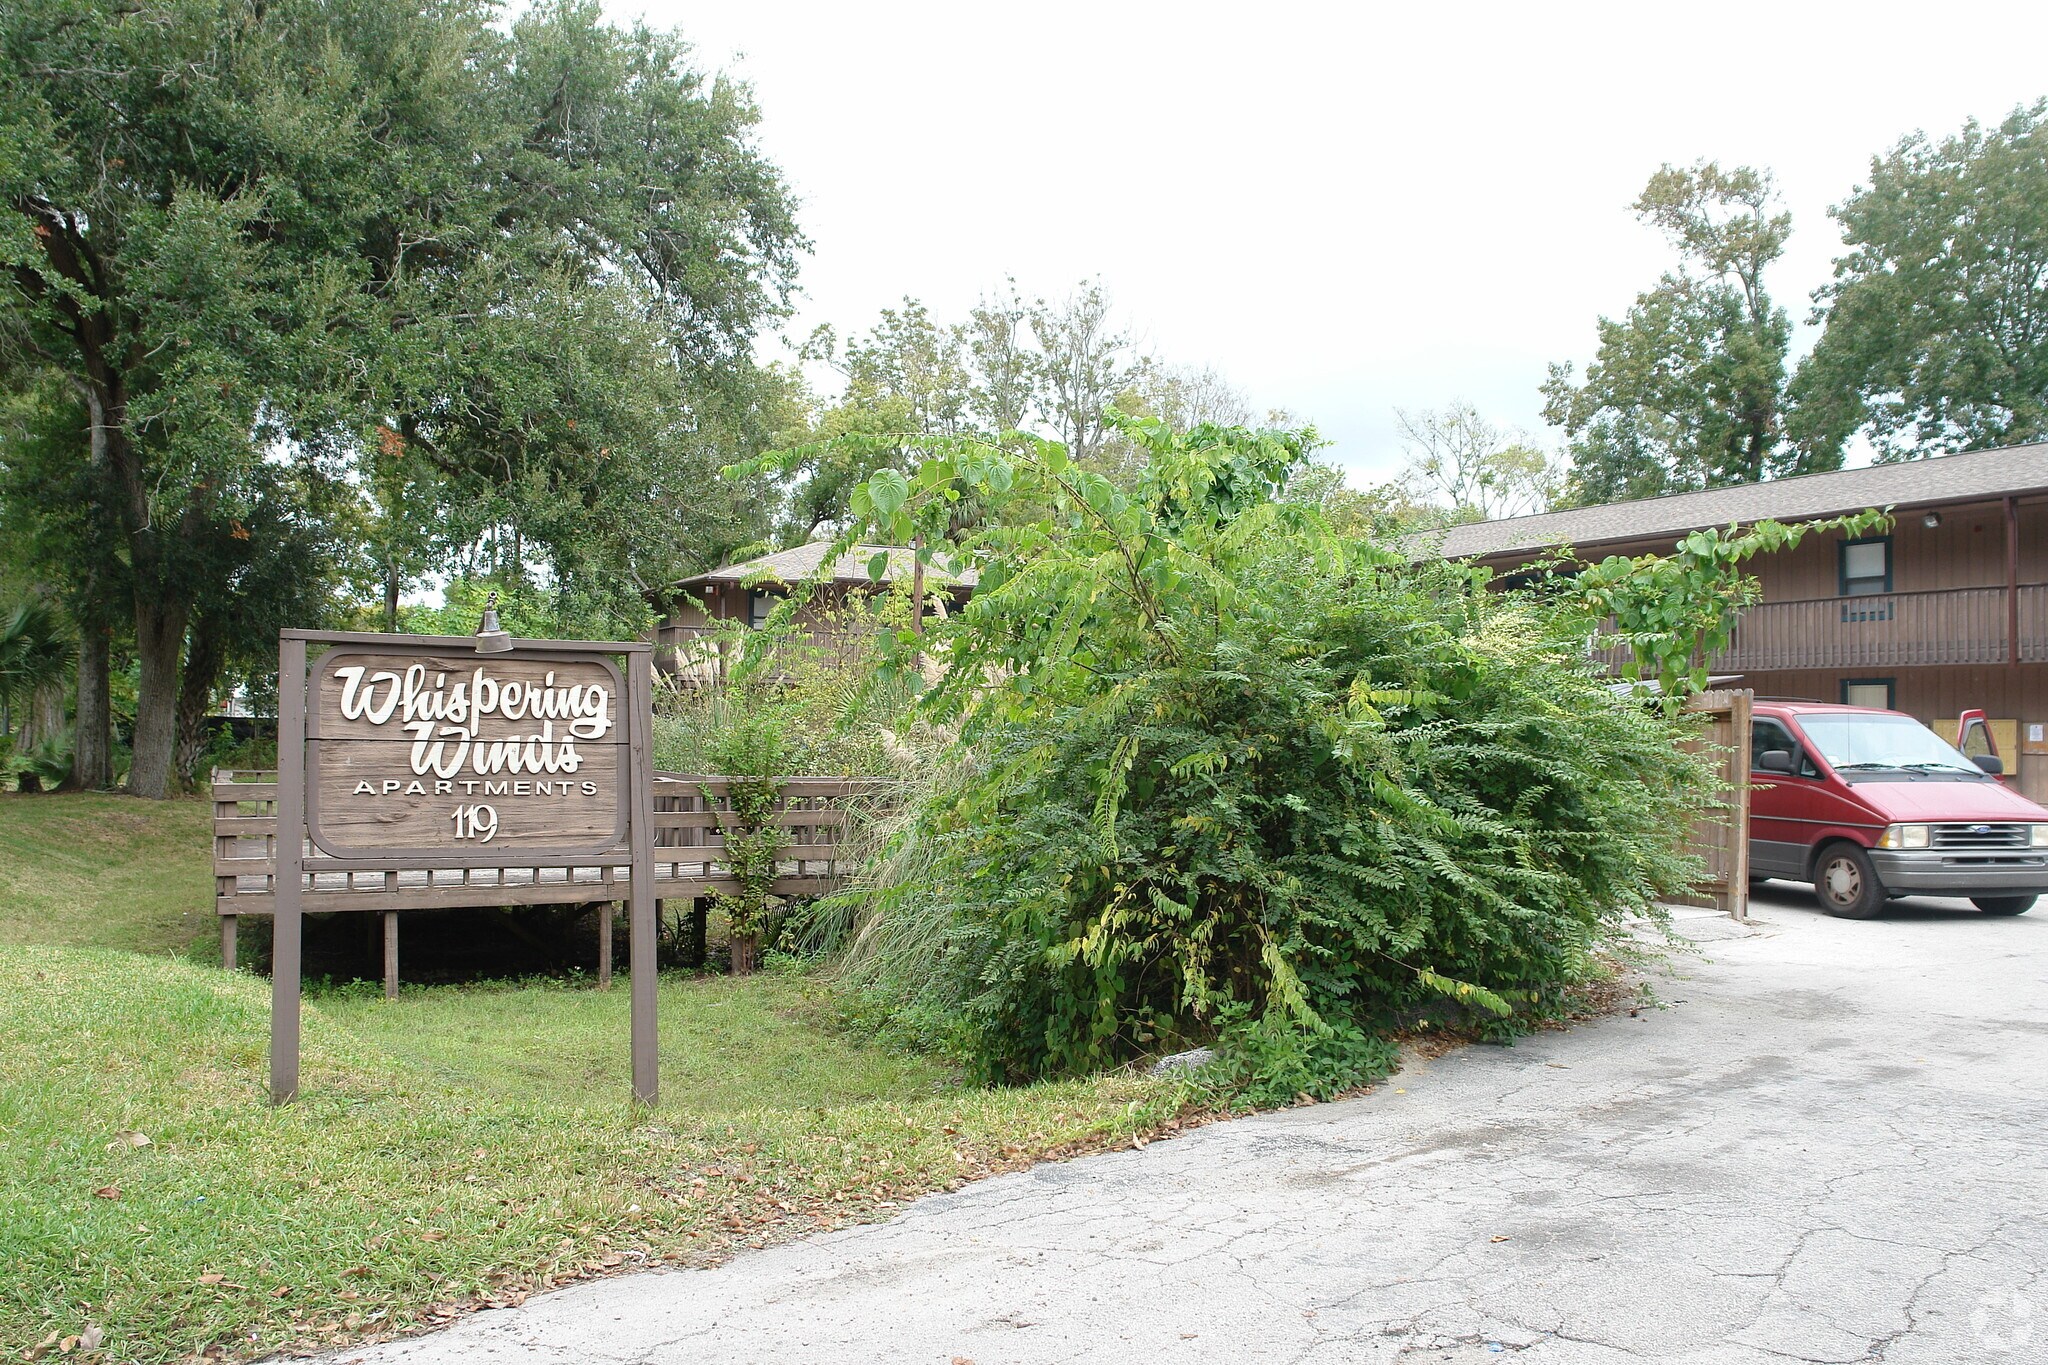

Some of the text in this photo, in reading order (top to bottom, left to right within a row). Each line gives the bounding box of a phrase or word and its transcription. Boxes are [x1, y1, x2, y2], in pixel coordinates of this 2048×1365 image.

[333, 664, 613, 739] Whispering
[402, 720, 583, 779] Winds
[353, 780, 598, 796] APARTMENTS
[451, 804, 498, 843] 119
